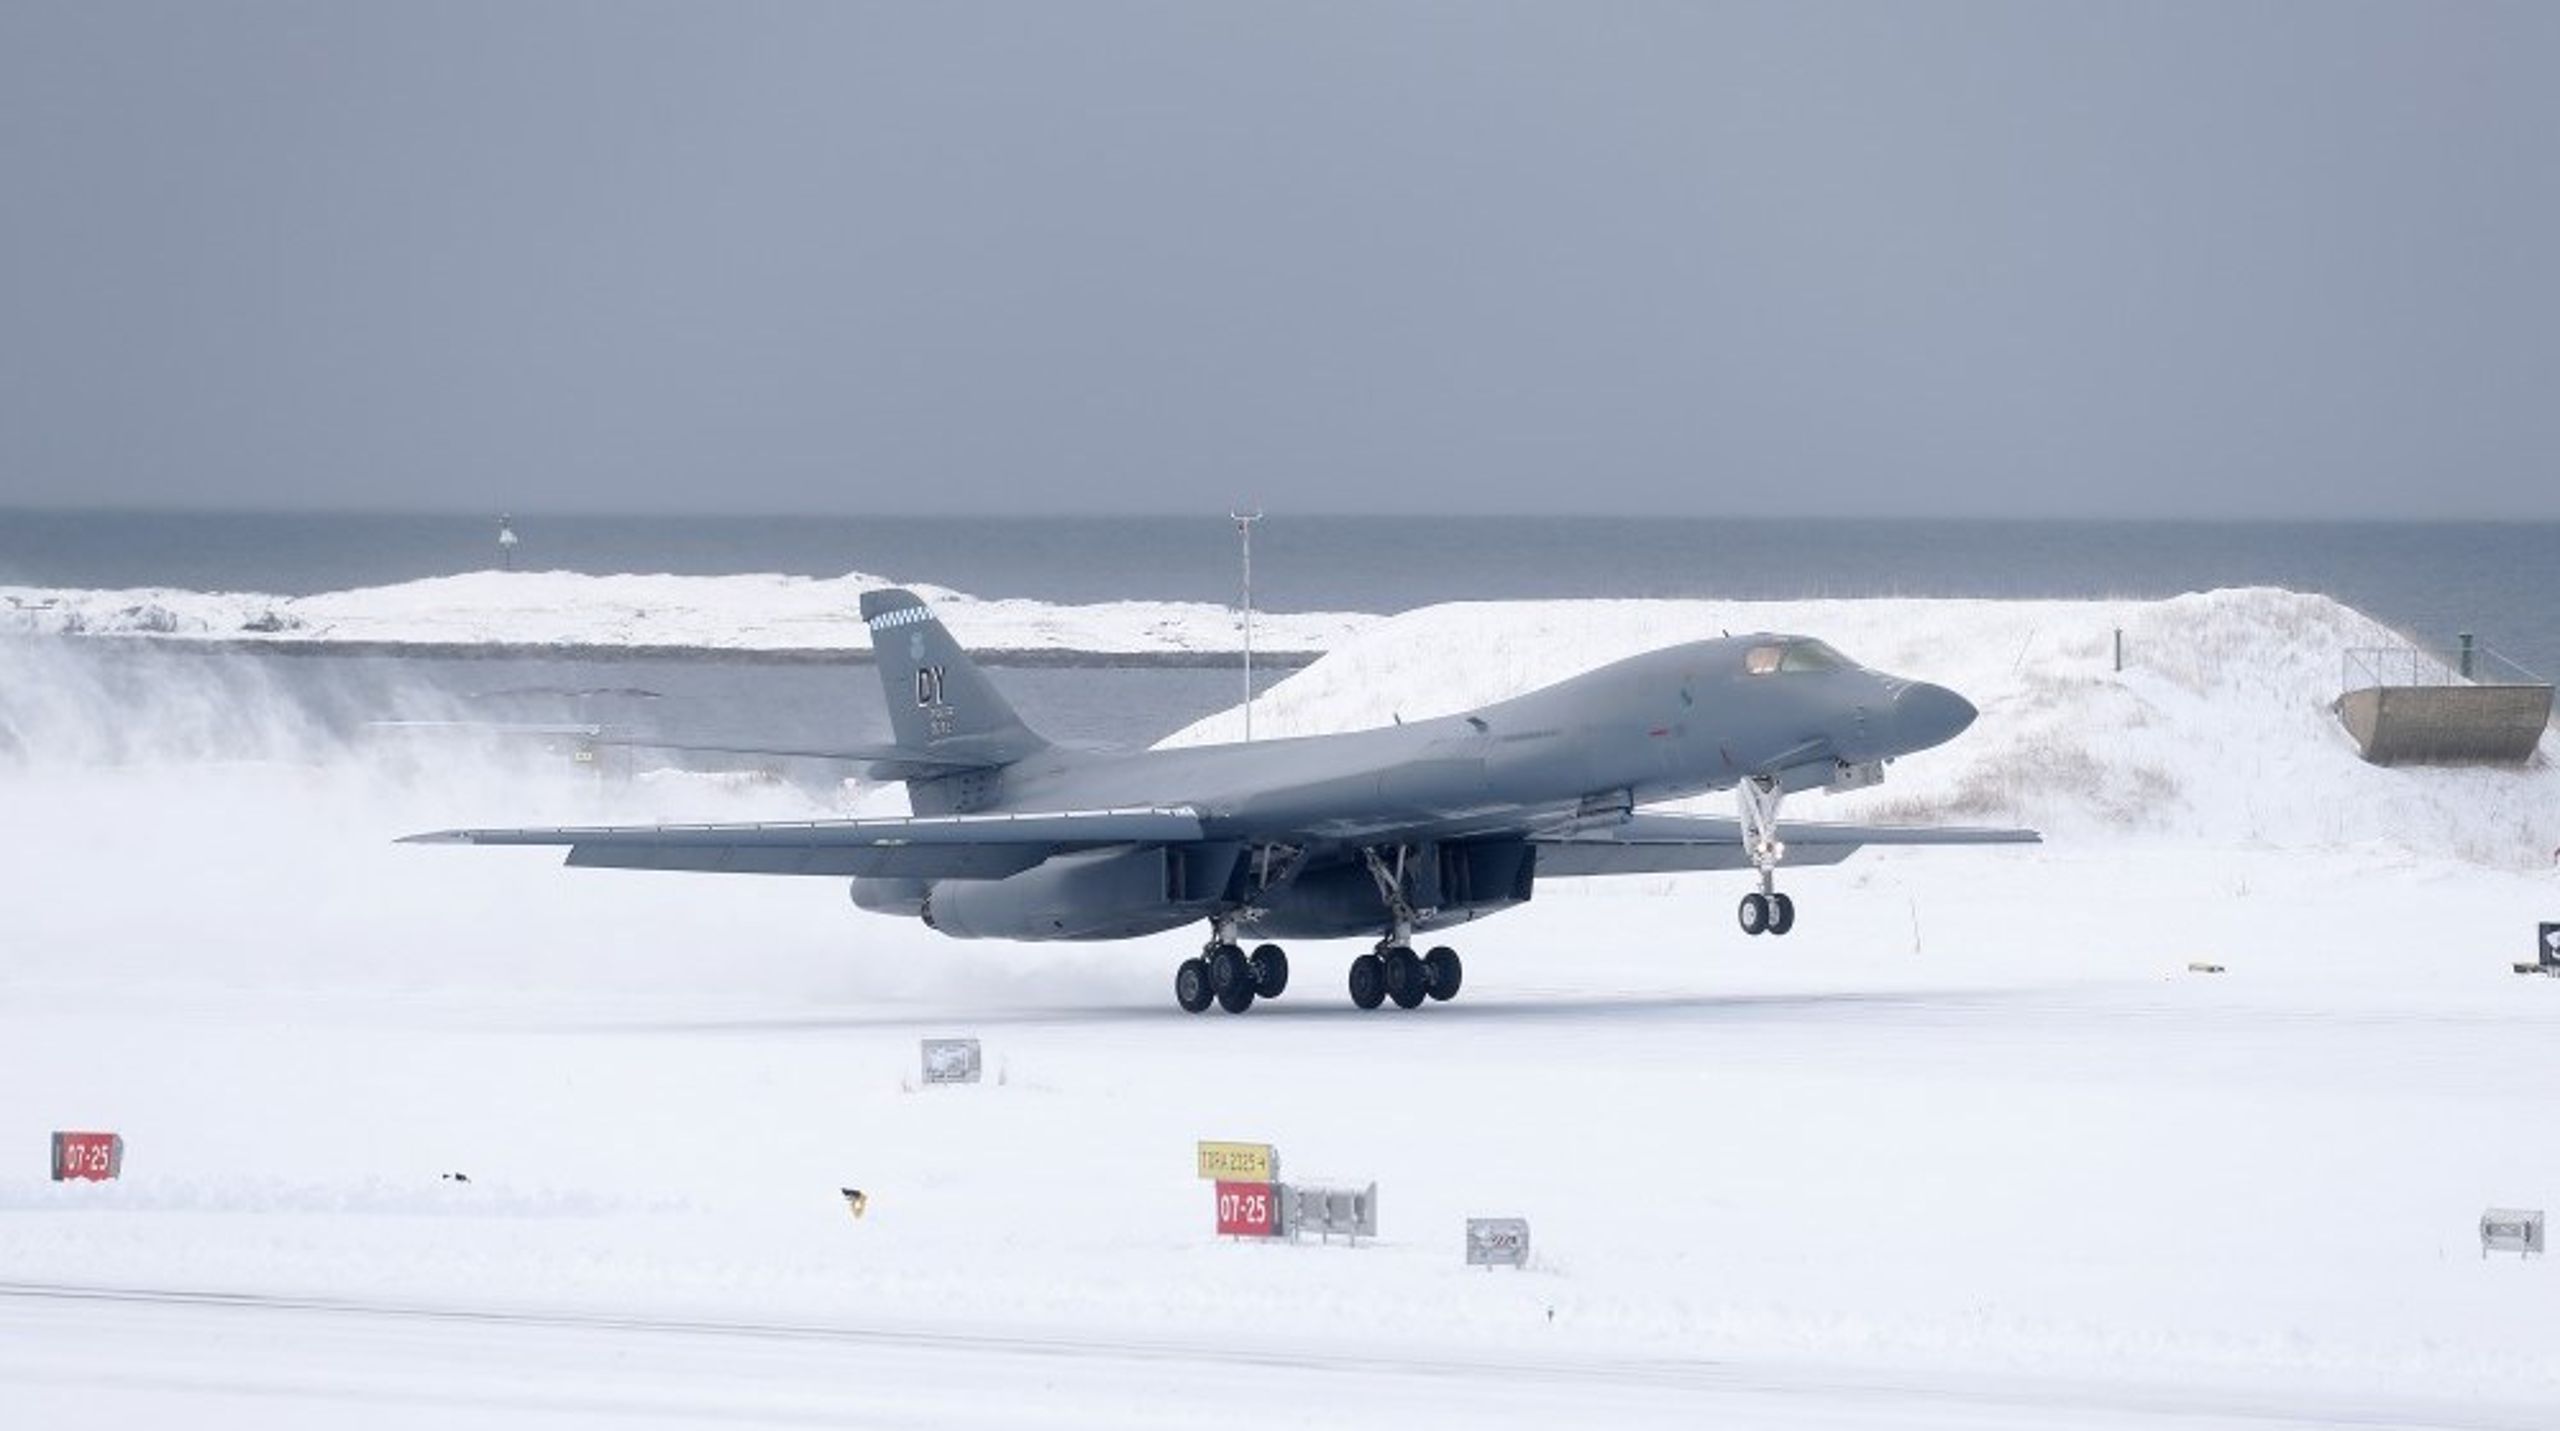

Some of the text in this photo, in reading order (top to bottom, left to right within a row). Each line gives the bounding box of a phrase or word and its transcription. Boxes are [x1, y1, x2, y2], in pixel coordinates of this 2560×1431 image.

[916, 666, 945, 707] DY
[68, 1144, 108, 1171] 07-25
[1221, 1194, 1266, 1223] 07-25
